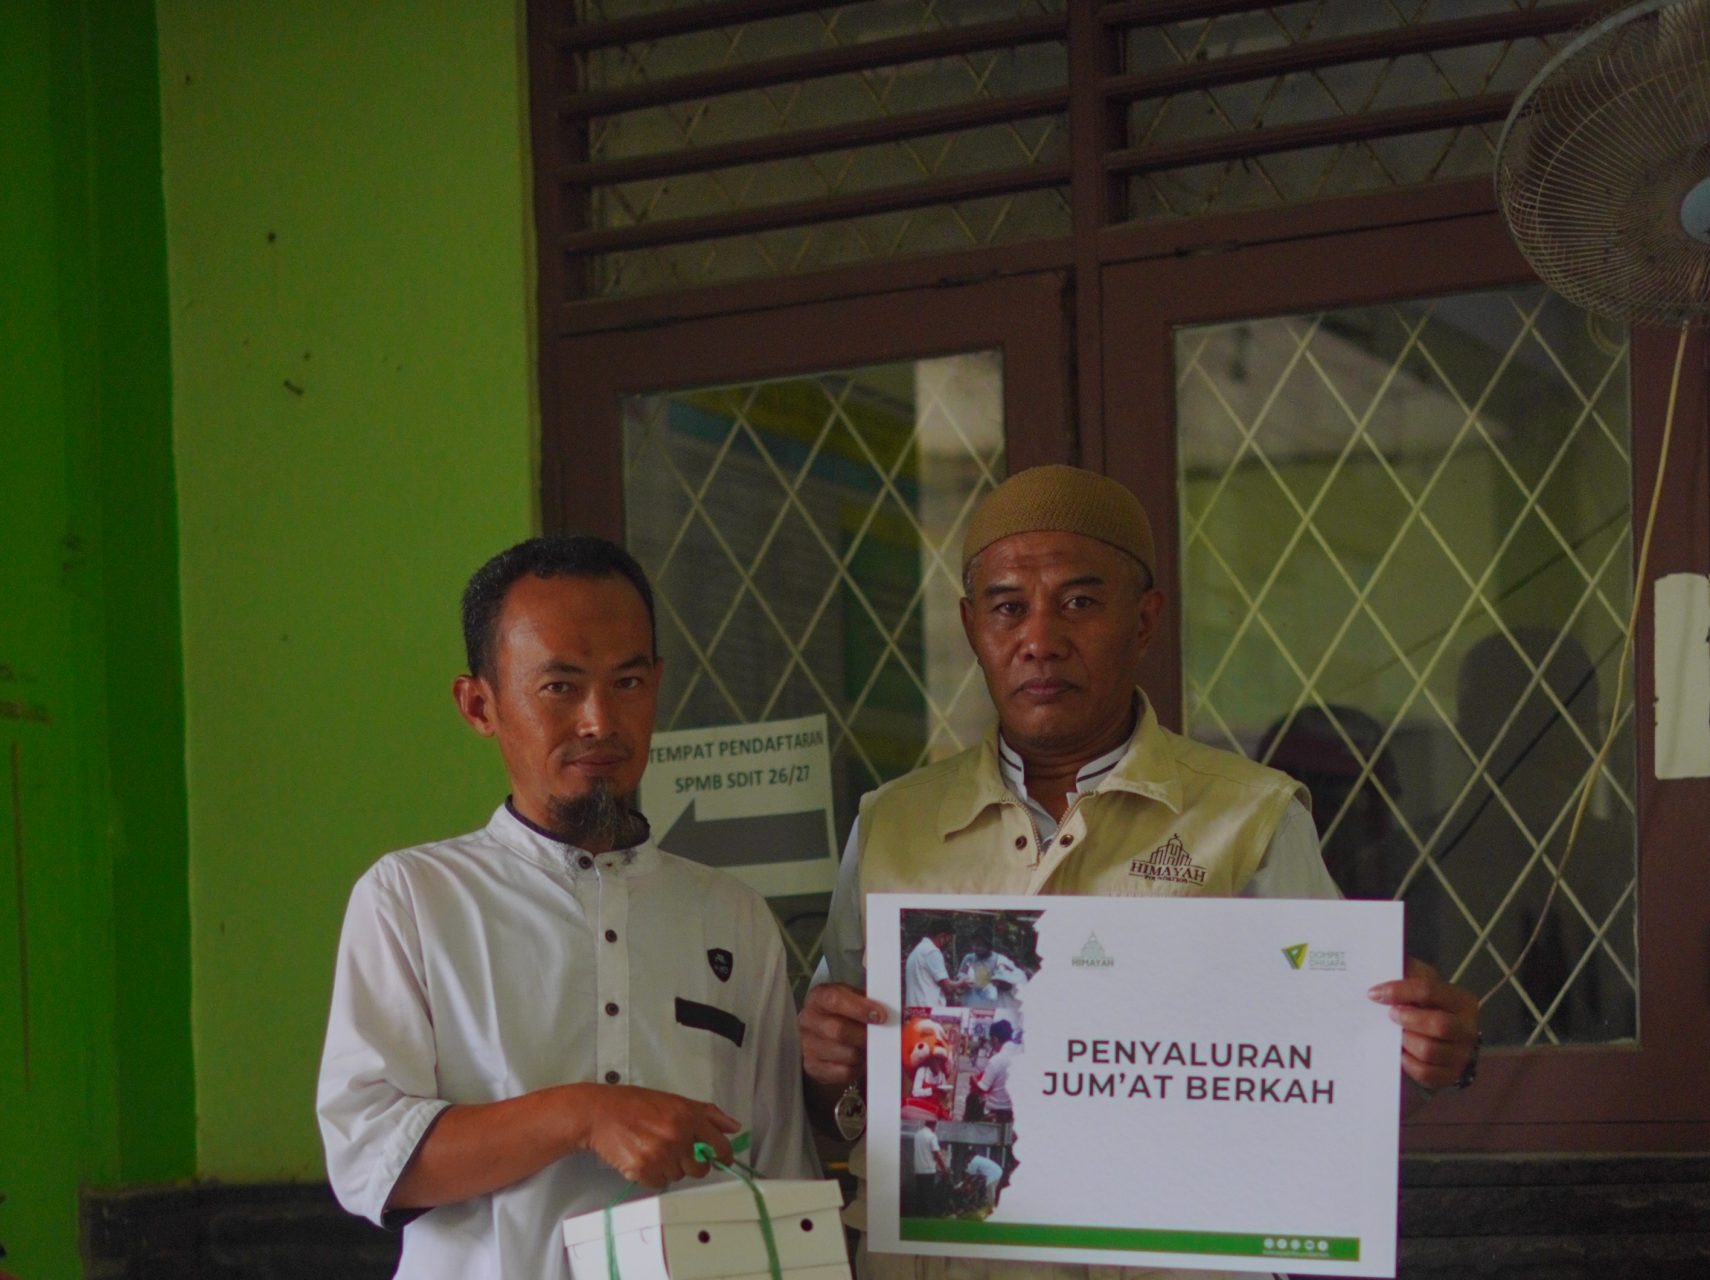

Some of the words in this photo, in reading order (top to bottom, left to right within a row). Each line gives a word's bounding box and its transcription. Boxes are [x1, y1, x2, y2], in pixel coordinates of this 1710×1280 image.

[650, 742, 714, 764] TEMPAT
[719, 730, 823, 756] PENDAFTARAN
[674, 775, 723, 793] SPMB
[726, 769, 763, 789] SDIT
[768, 764, 810, 786] 26/27
[1130, 861, 1206, 882] HIMAYAH
[1067, 1038, 1312, 1069] PENYALURAN
[1042, 1072, 1173, 1099] JUM'AT
[1186, 1075, 1334, 1104] BERKAH
